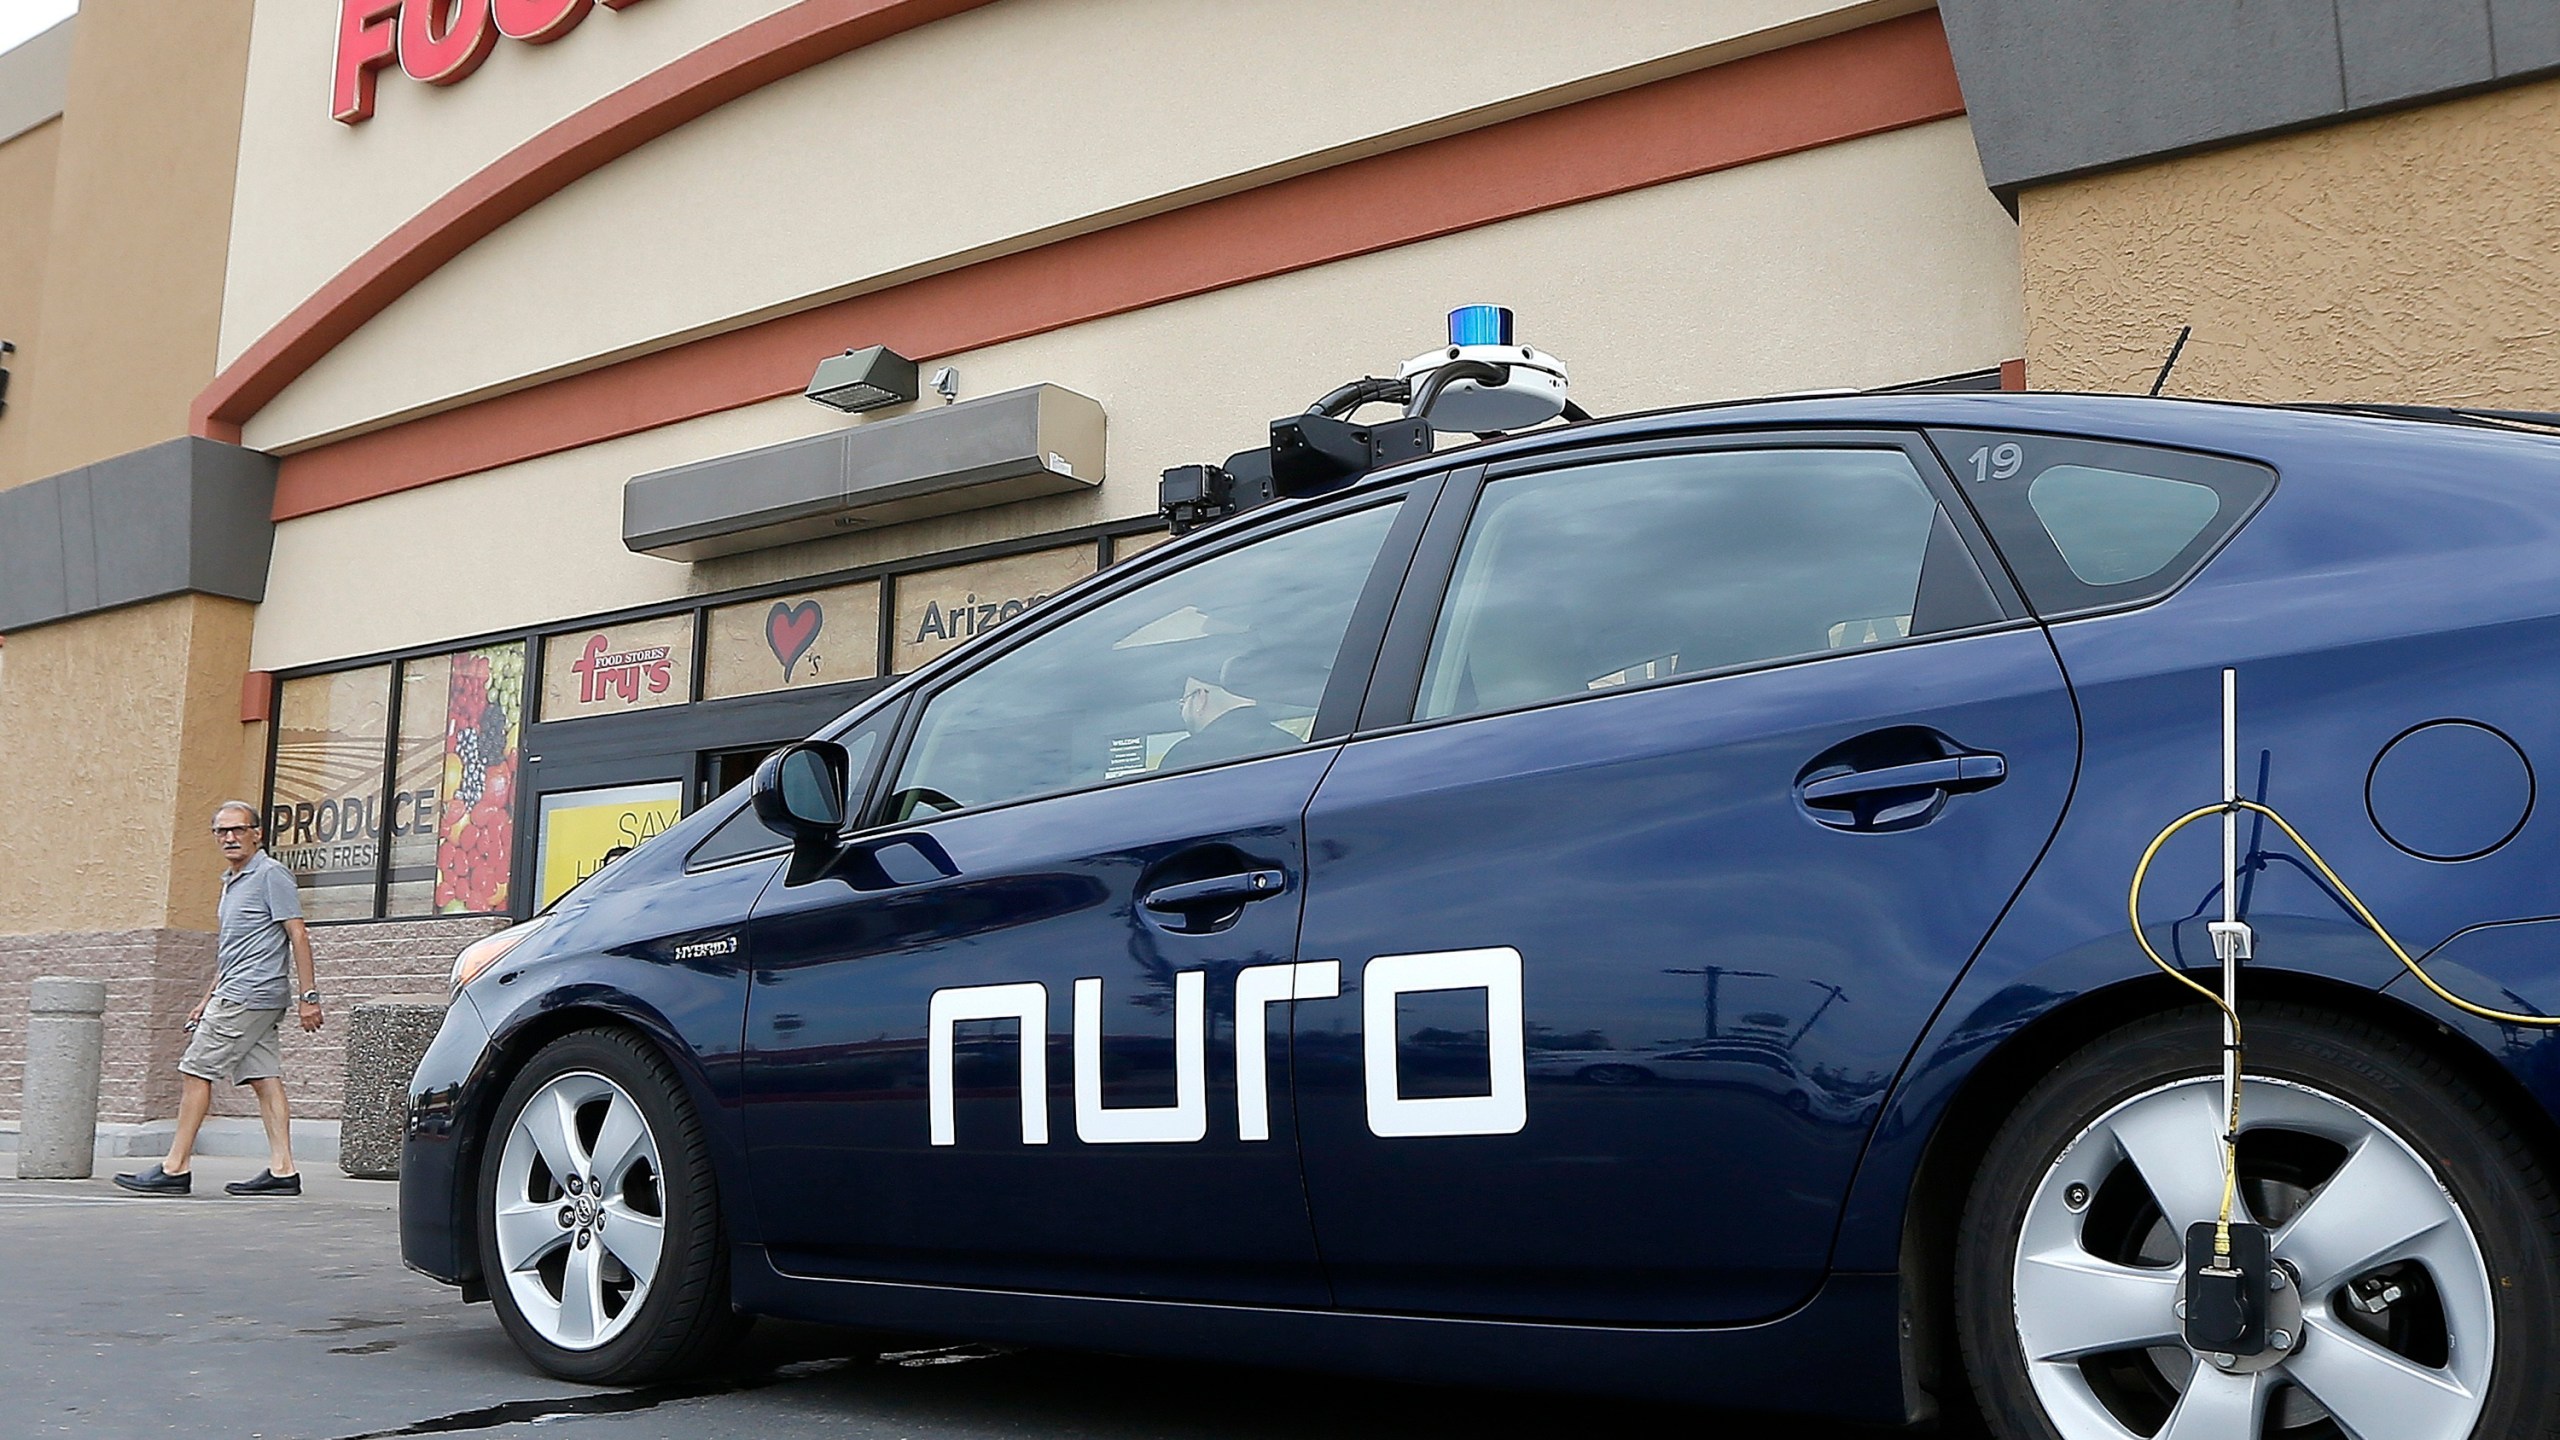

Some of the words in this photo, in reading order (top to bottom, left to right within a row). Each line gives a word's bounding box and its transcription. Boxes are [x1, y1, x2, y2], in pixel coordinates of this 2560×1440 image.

[329, 0, 643, 125] FO
[1968, 442, 2023, 482] 19
[917, 593, 1049, 643] Arizo
[572, 634, 671, 703] fry's
[595, 654, 623, 668] FOOD
[625, 647, 665, 664] STORES
[272, 789, 435, 846] PRODUCE
[617, 810, 679, 849] SAY
[332, 843, 379, 868] FRESH
[675, 940, 728, 960] HYBRID
[929, 944, 1527, 1146] nuro
